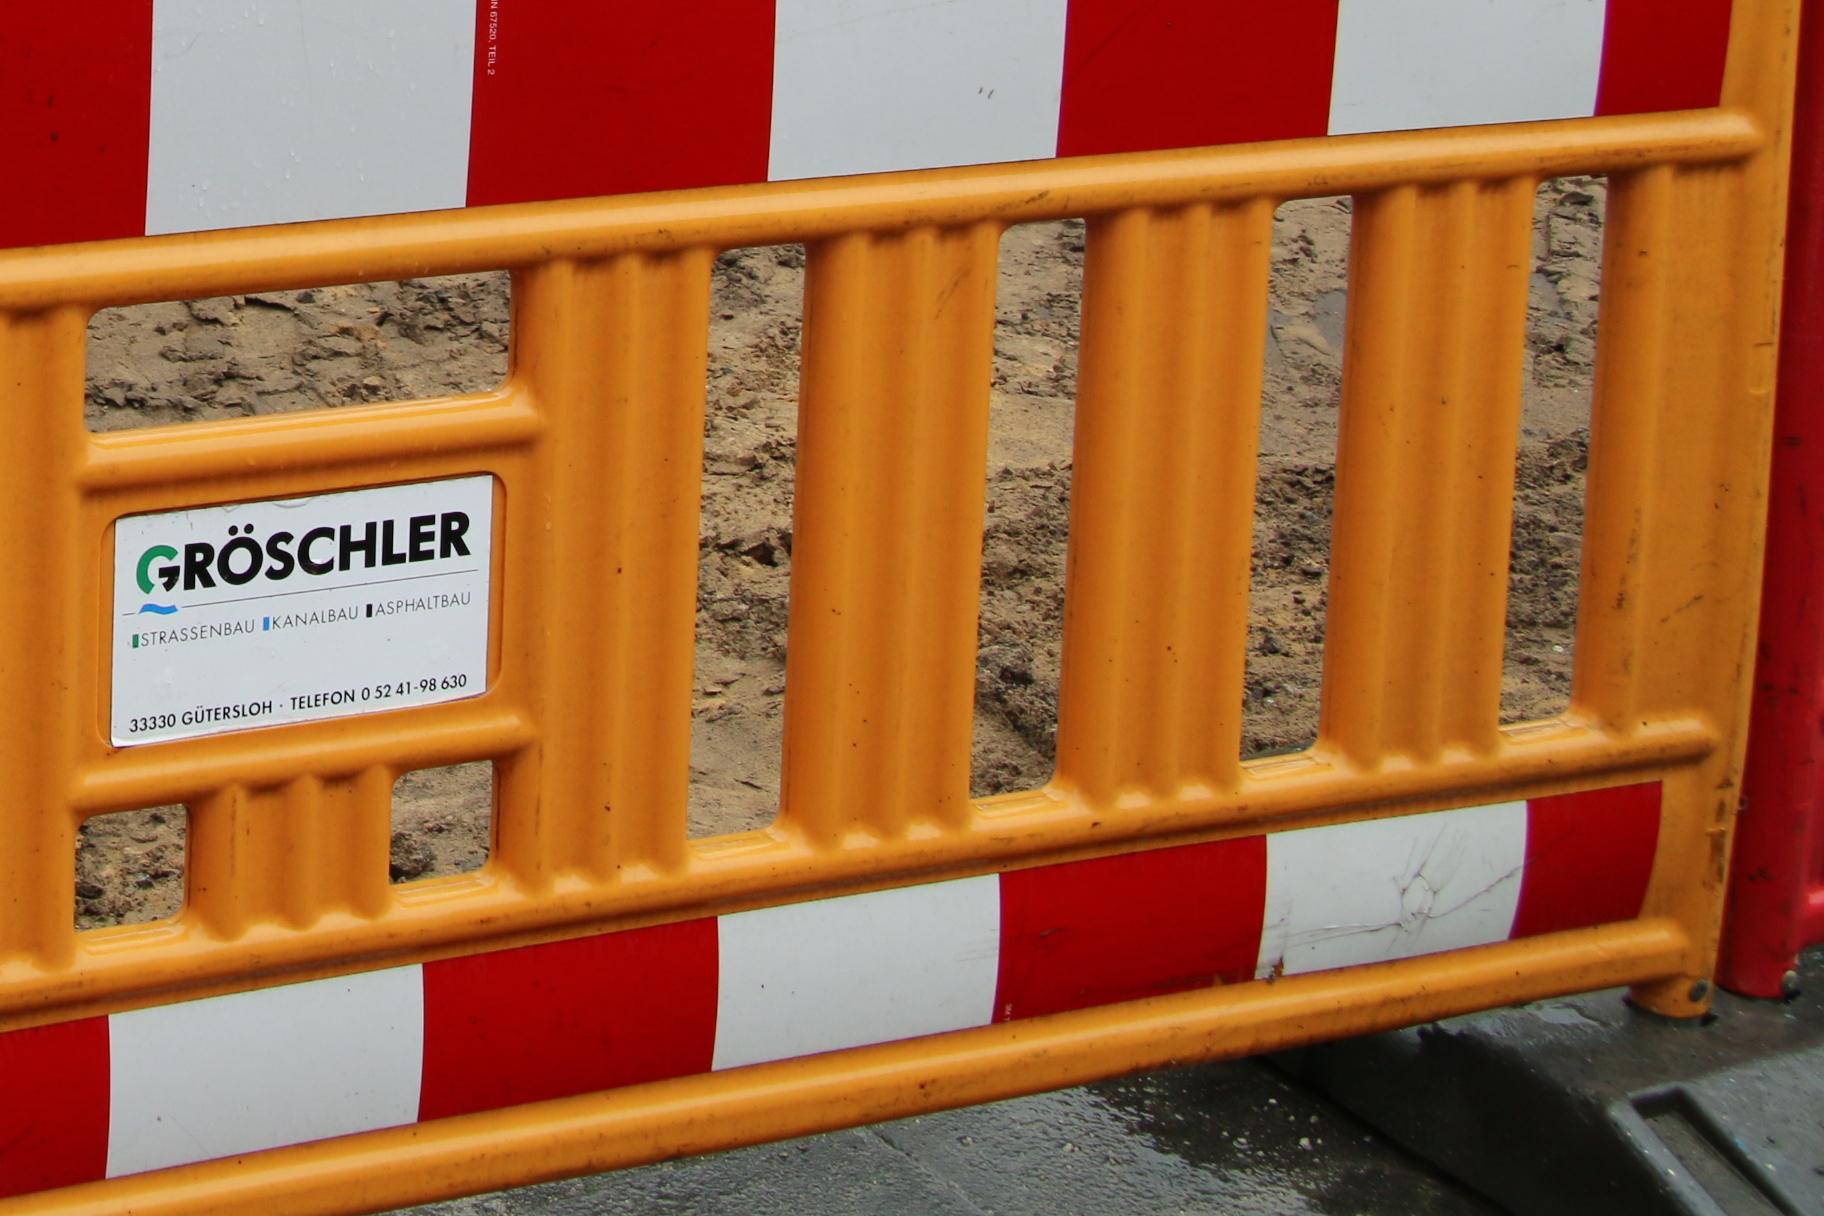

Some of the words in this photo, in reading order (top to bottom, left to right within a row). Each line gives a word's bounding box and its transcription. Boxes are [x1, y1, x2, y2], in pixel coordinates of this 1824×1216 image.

[487, 45, 497, 67] TEIL
[136, 511, 471, 595] GRÖSCHLER
[140, 619, 255, 648] STRASSENBAU
[272, 606, 359, 631] KANALBAU
[375, 591, 472, 617] ASPHALTBAU
[129, 714, 176, 733] 33330
[181, 700, 273, 726] GÜTERSLOH
[290, 689, 355, 711] TELEFON
[361, 687, 371, 701] 0
[374, 684, 392, 700] 52
[440, 674, 467, 691] 630
